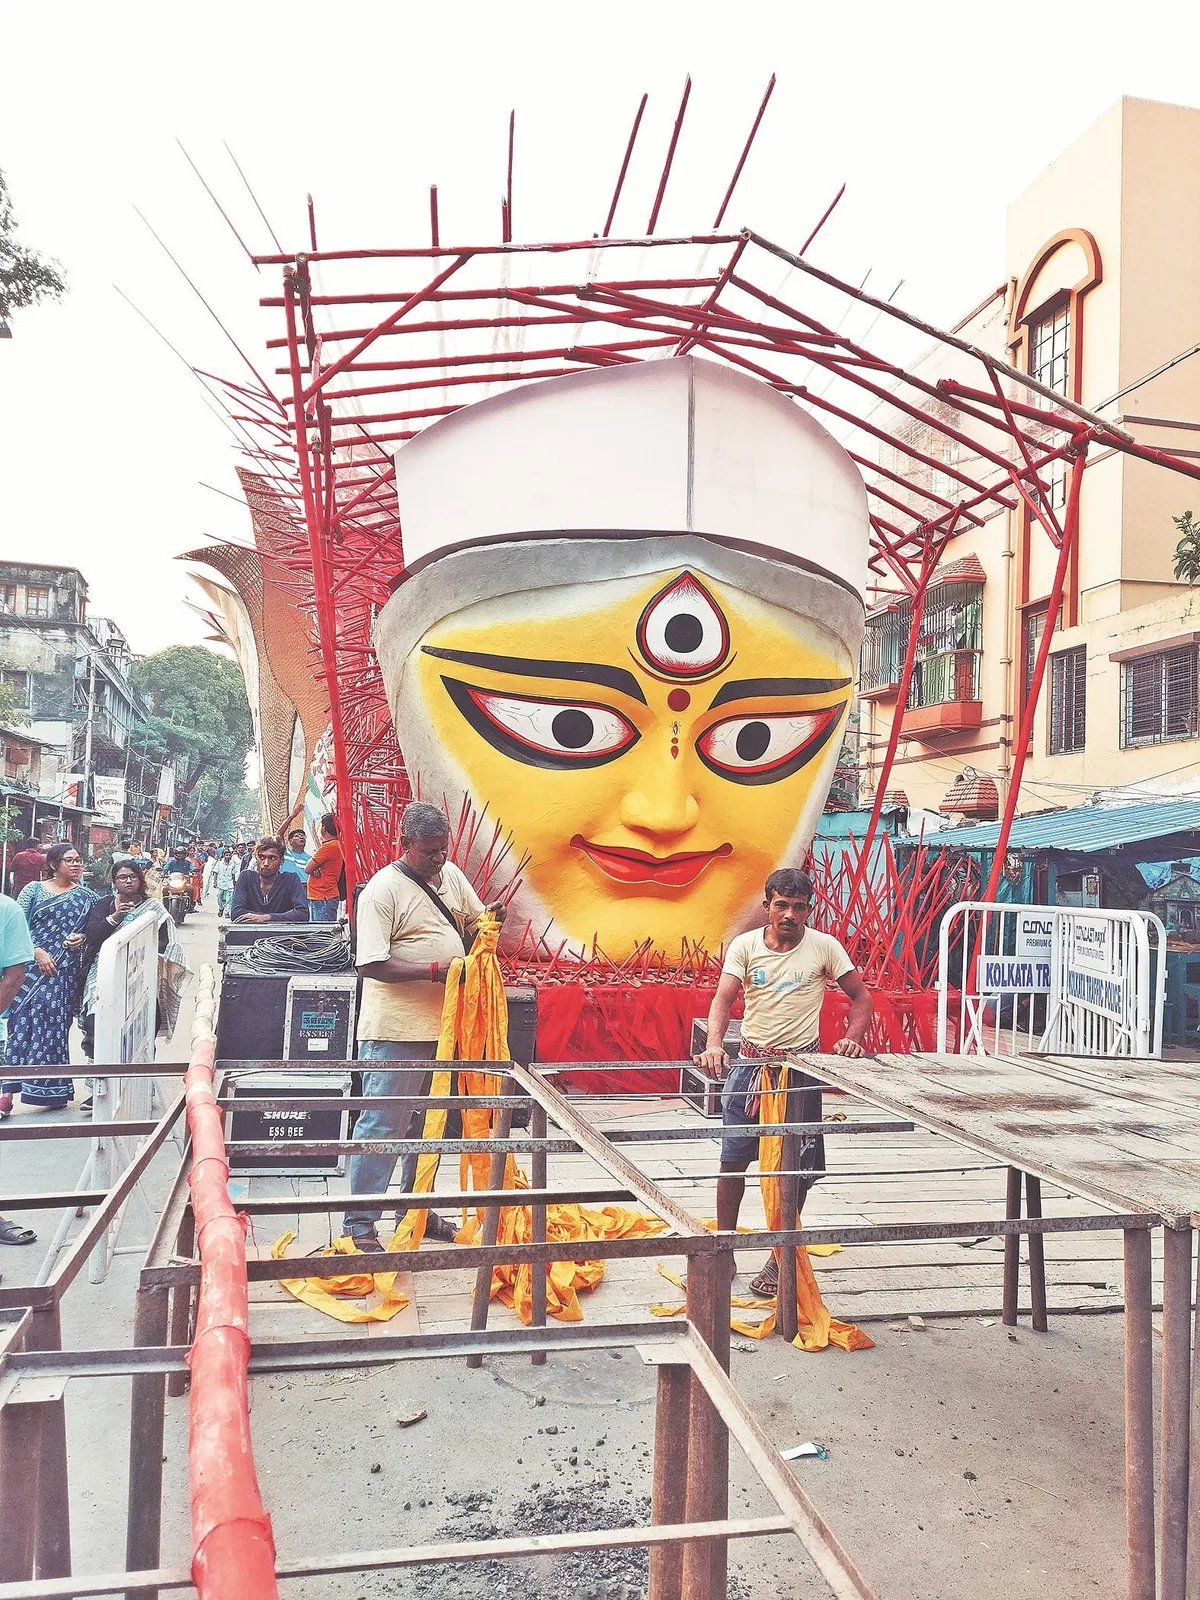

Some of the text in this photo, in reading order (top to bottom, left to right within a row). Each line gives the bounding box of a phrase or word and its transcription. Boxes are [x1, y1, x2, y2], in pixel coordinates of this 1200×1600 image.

[1023, 920, 1052, 935] CONC
[1026, 938, 1048, 947] PREMIUM
[986, 963, 1033, 987] KOLKATA
[1069, 970, 1121, 1014] KOLKATA TRAFFIC POLICE
[263, 1111, 307, 1120] SHURE
[269, 1126, 304, 1137] ESS BEE
